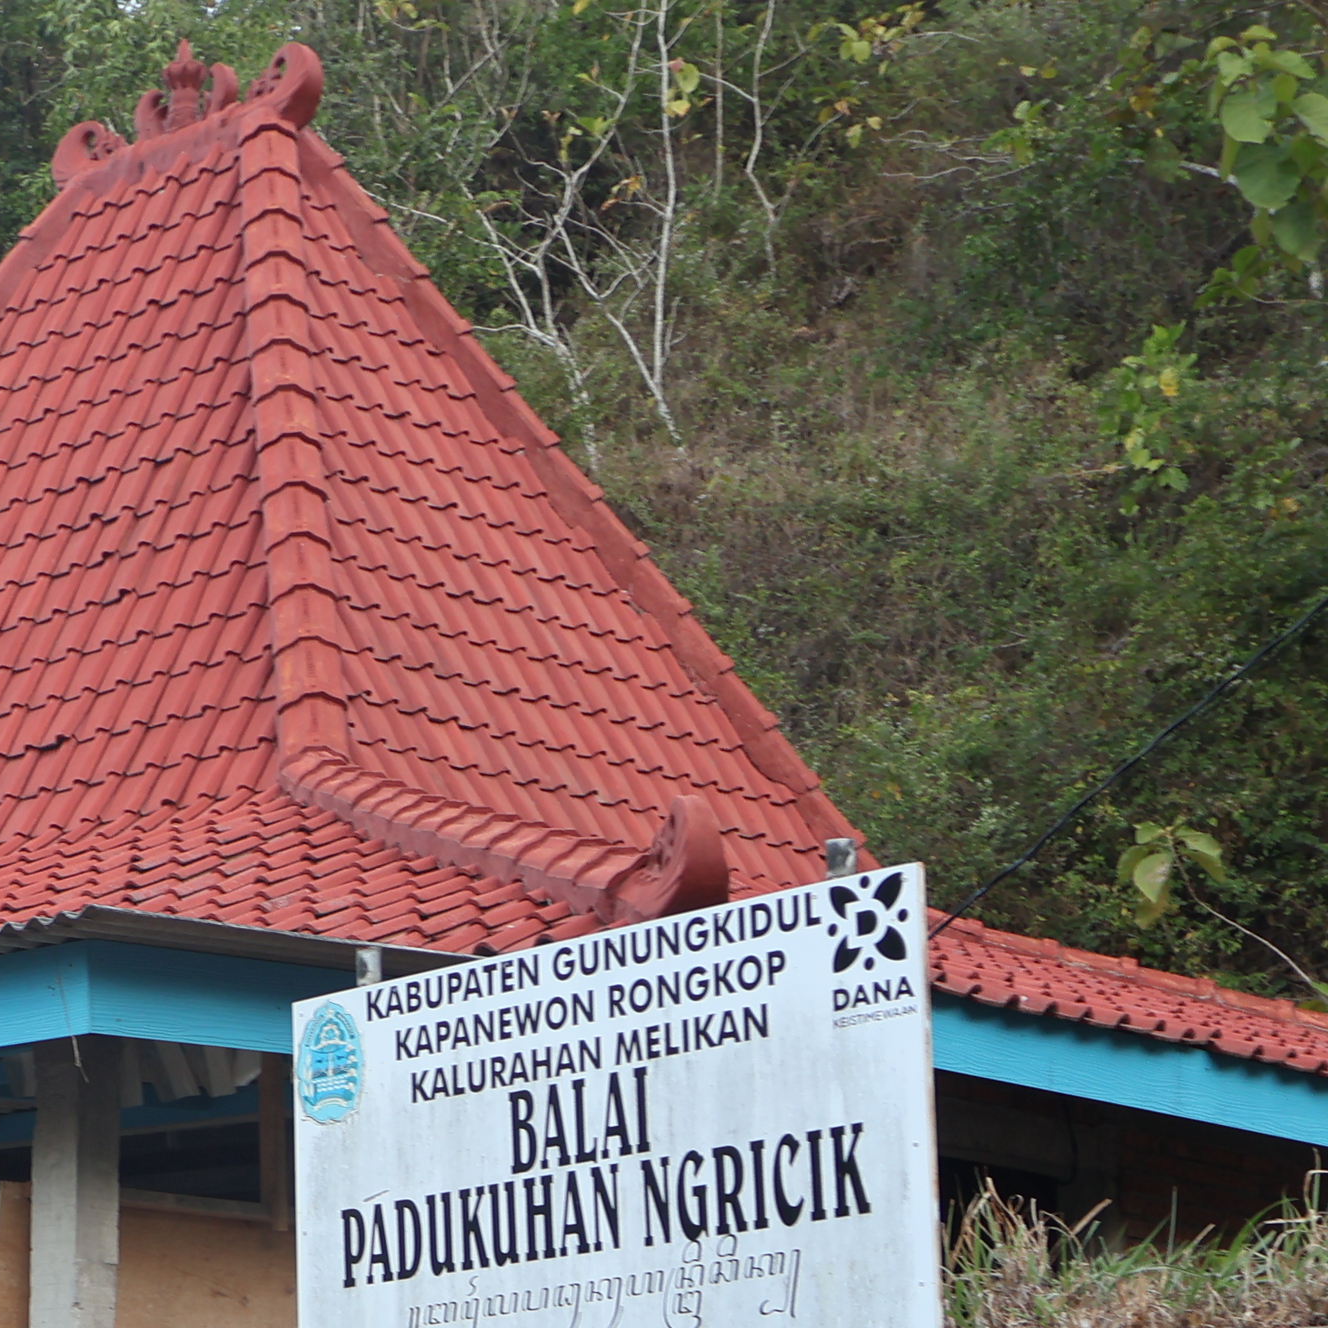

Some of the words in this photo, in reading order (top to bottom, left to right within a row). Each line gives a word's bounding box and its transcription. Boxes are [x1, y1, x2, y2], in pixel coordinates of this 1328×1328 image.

[365, 953, 540, 1022] KABUPATEN
[552, 890, 823, 982] GUNUNGKIDUL
[394, 989, 596, 1062] KAPANEWON
[607, 949, 787, 1019] RONGKOP
[831, 975, 916, 1013] DANA
[409, 1034, 602, 1105] KALURAHAN
[614, 1001, 770, 1067] MELIKAN
[507, 1065, 652, 1176] BALAI
[340, 1162, 622, 1290] PADUKUHAN
[639, 1121, 872, 1248] NGRICIK
